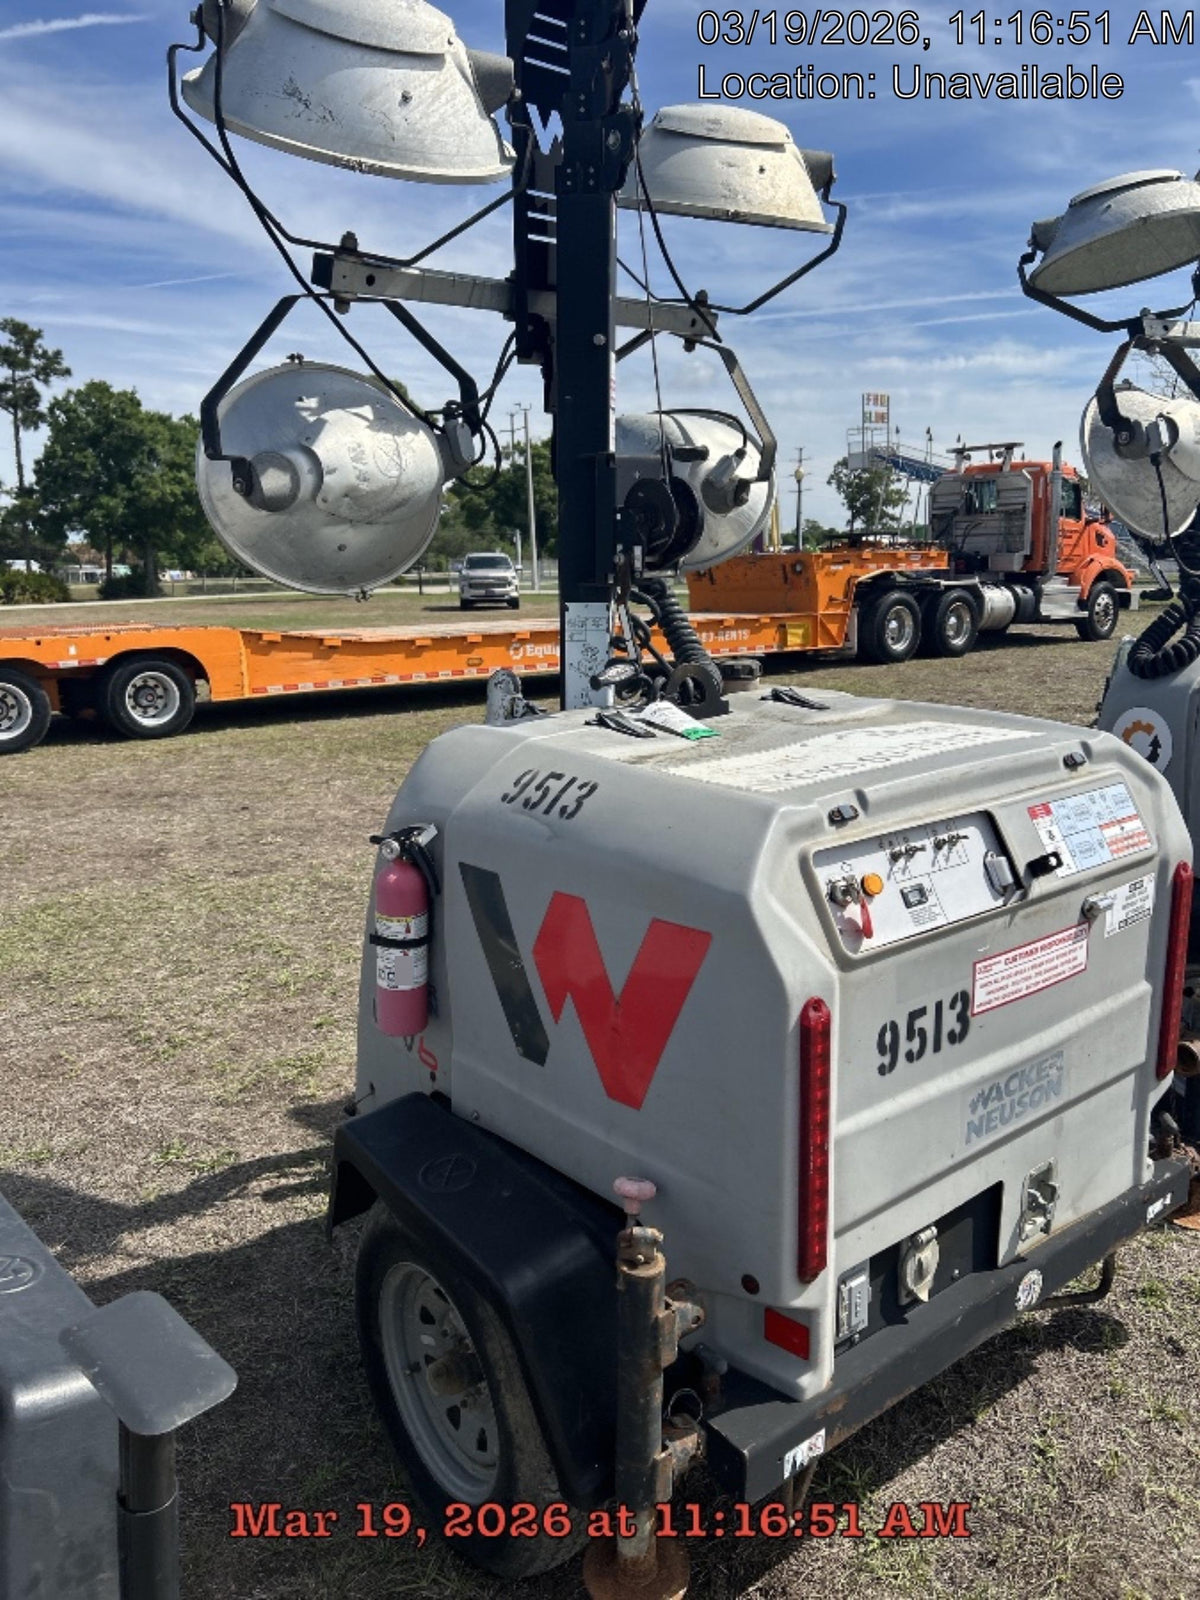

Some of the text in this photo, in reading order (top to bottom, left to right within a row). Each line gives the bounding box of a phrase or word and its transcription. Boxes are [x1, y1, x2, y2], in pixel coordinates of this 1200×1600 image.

[501, 768, 599, 820] 9513
[876, 989, 970, 1076] 9513
[964, 1074, 1063, 1146] NEUSON
[968, 1050, 1064, 1115] WACKER
